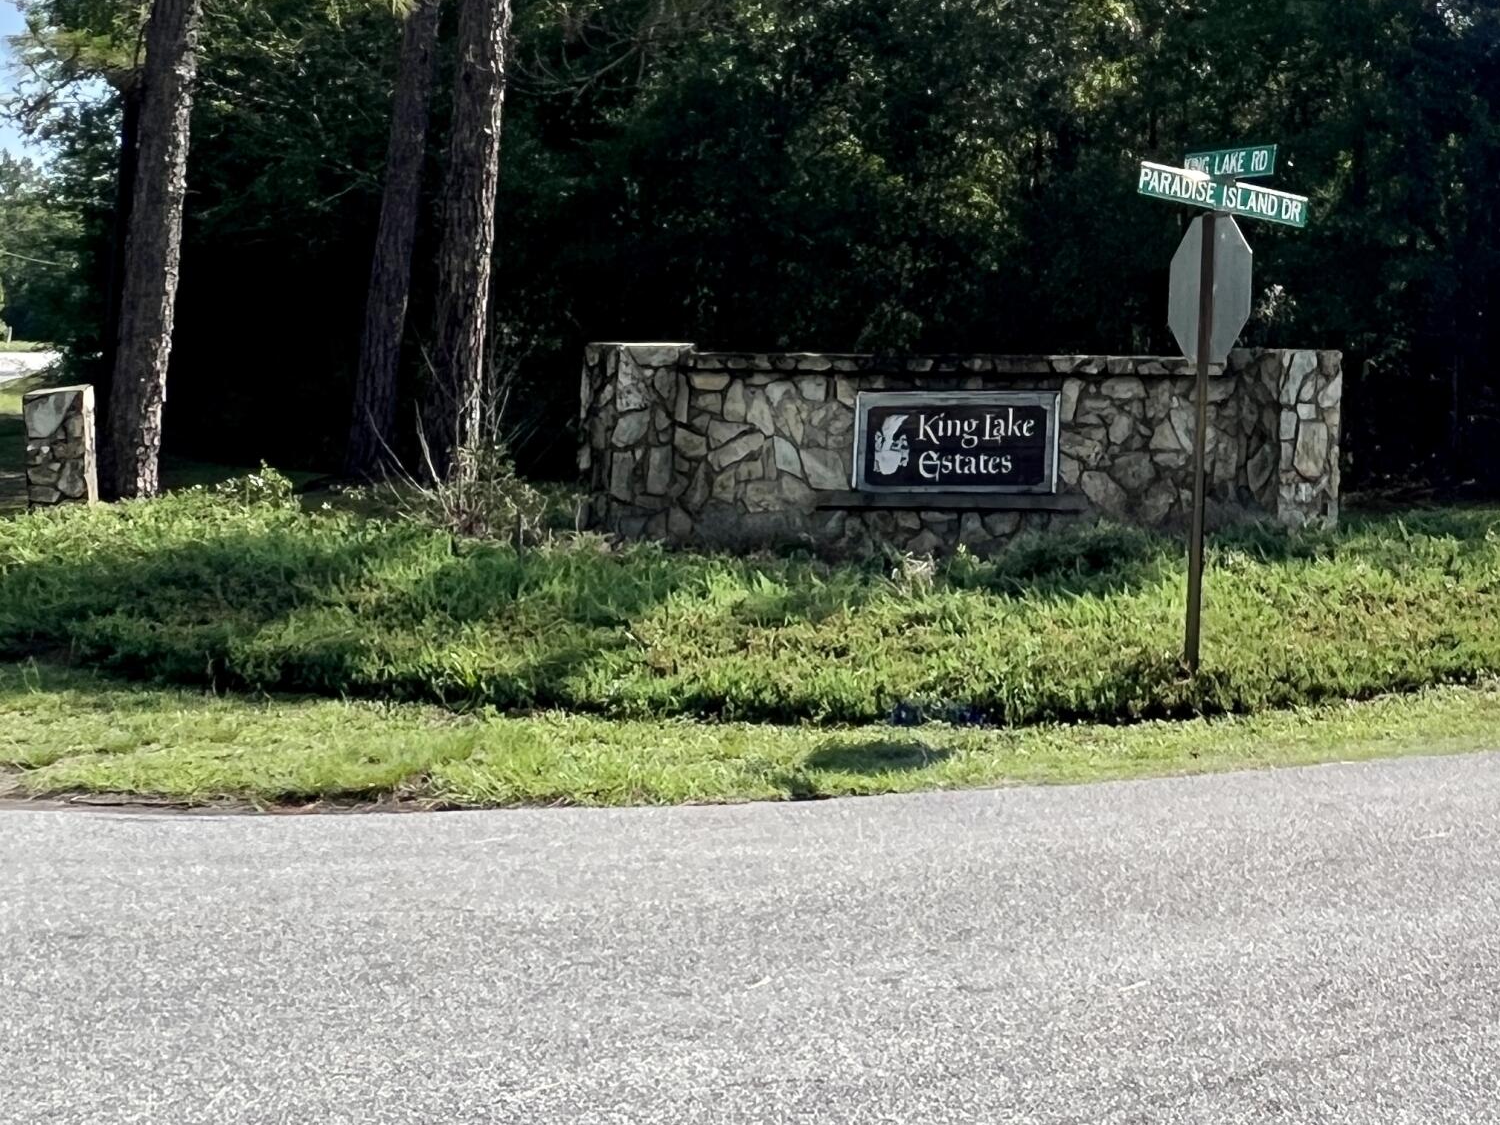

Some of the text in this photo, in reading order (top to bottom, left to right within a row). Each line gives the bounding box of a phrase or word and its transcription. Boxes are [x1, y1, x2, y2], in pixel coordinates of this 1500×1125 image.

[1214, 151, 1245, 175] LAKE
[1251, 150, 1268, 172] RD
[1139, 168, 1302, 223] PARADISE ISLAND DR
[915, 407, 1035, 449] King Lake
[918, 450, 1013, 482] Estates
